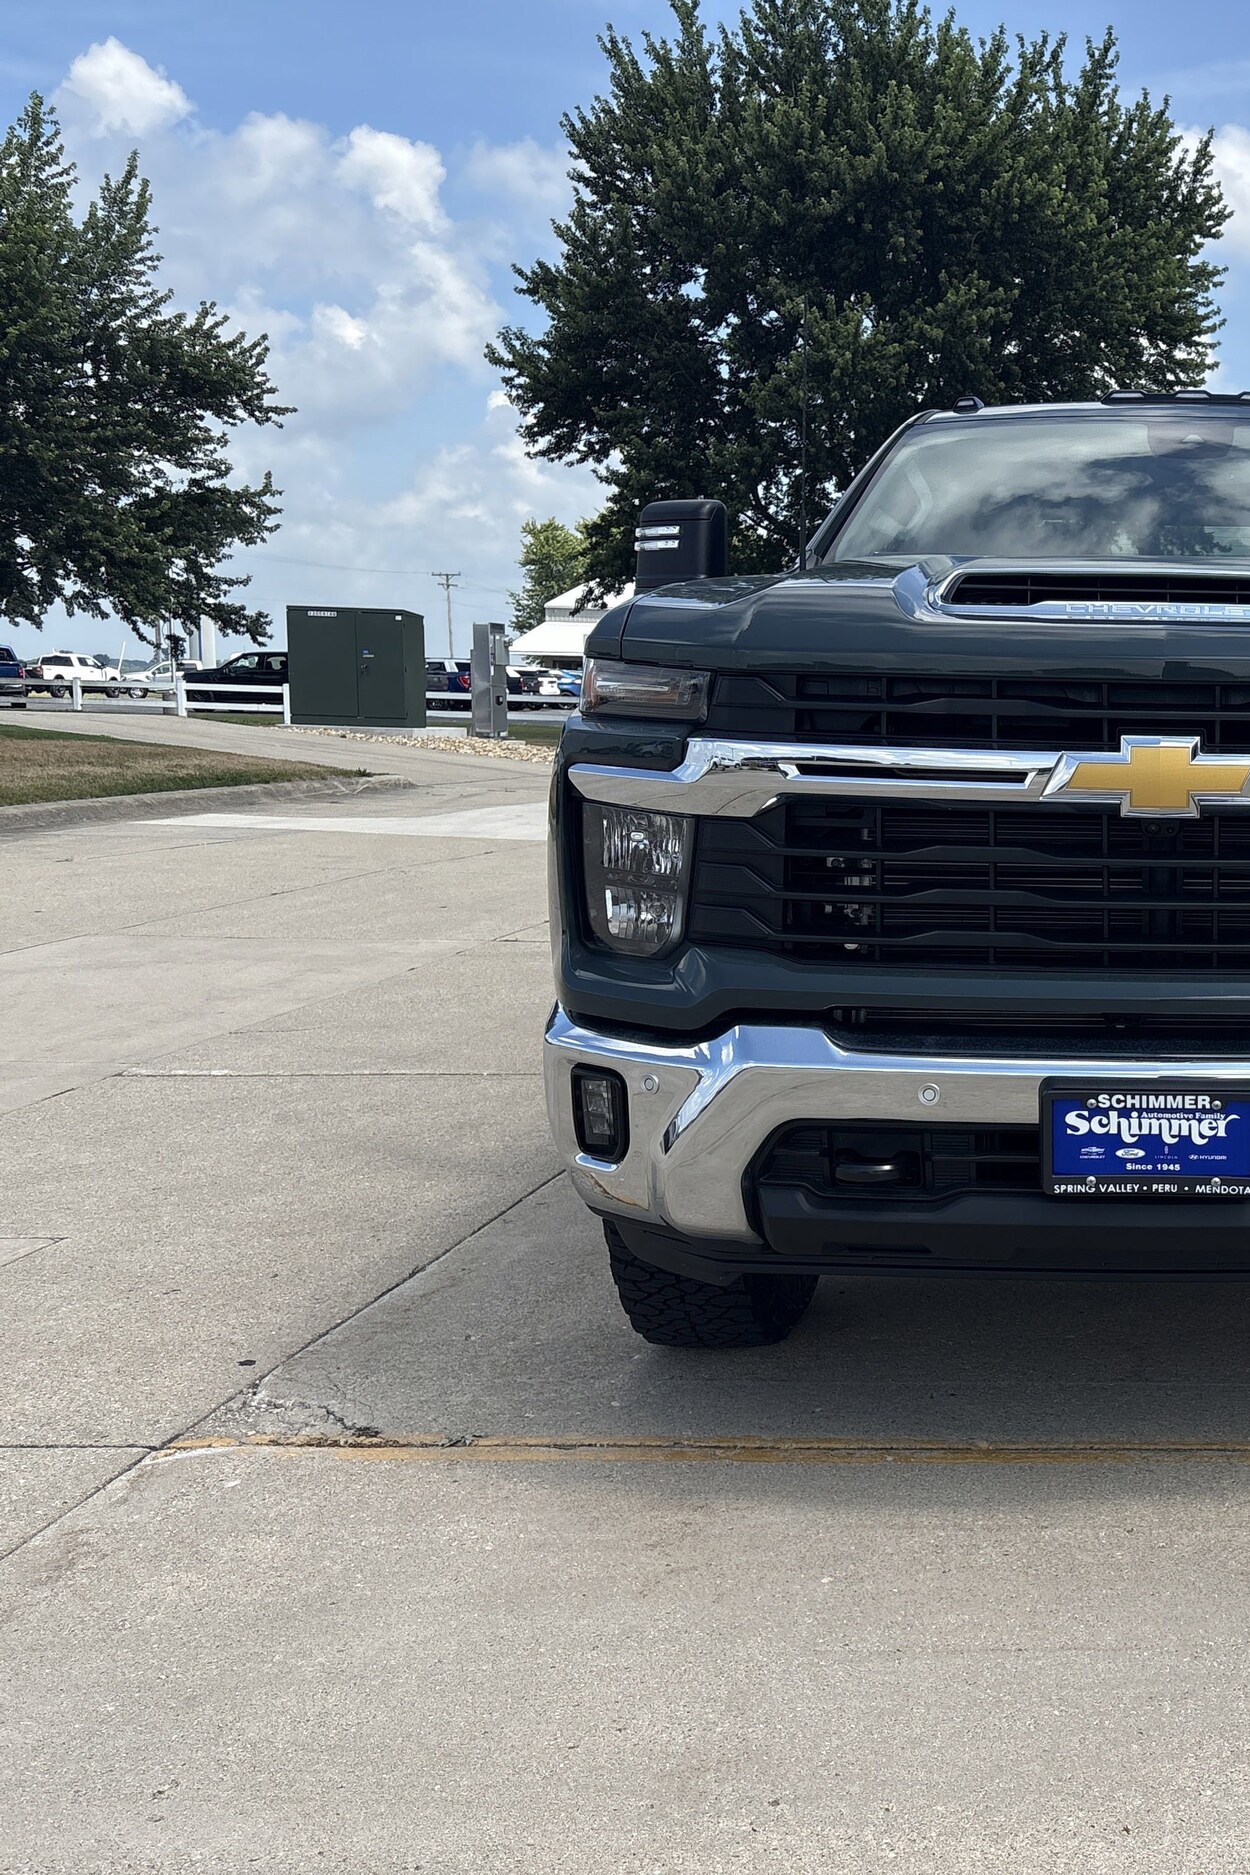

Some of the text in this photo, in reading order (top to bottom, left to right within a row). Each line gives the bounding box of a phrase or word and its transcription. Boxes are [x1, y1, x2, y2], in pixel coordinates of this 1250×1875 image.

[1097, 1094, 1211, 1109] SCHIMMER
[1141, 1111, 1226, 1121] Automotive Family
[1065, 1111, 1241, 1145] Schimmer
[1126, 1162, 1181, 1171] Since 1945
[1054, 1184, 1096, 1193] SPRING
[1099, 1183, 1140, 1193] VALLEY
[1152, 1184, 1178, 1193] PERU
